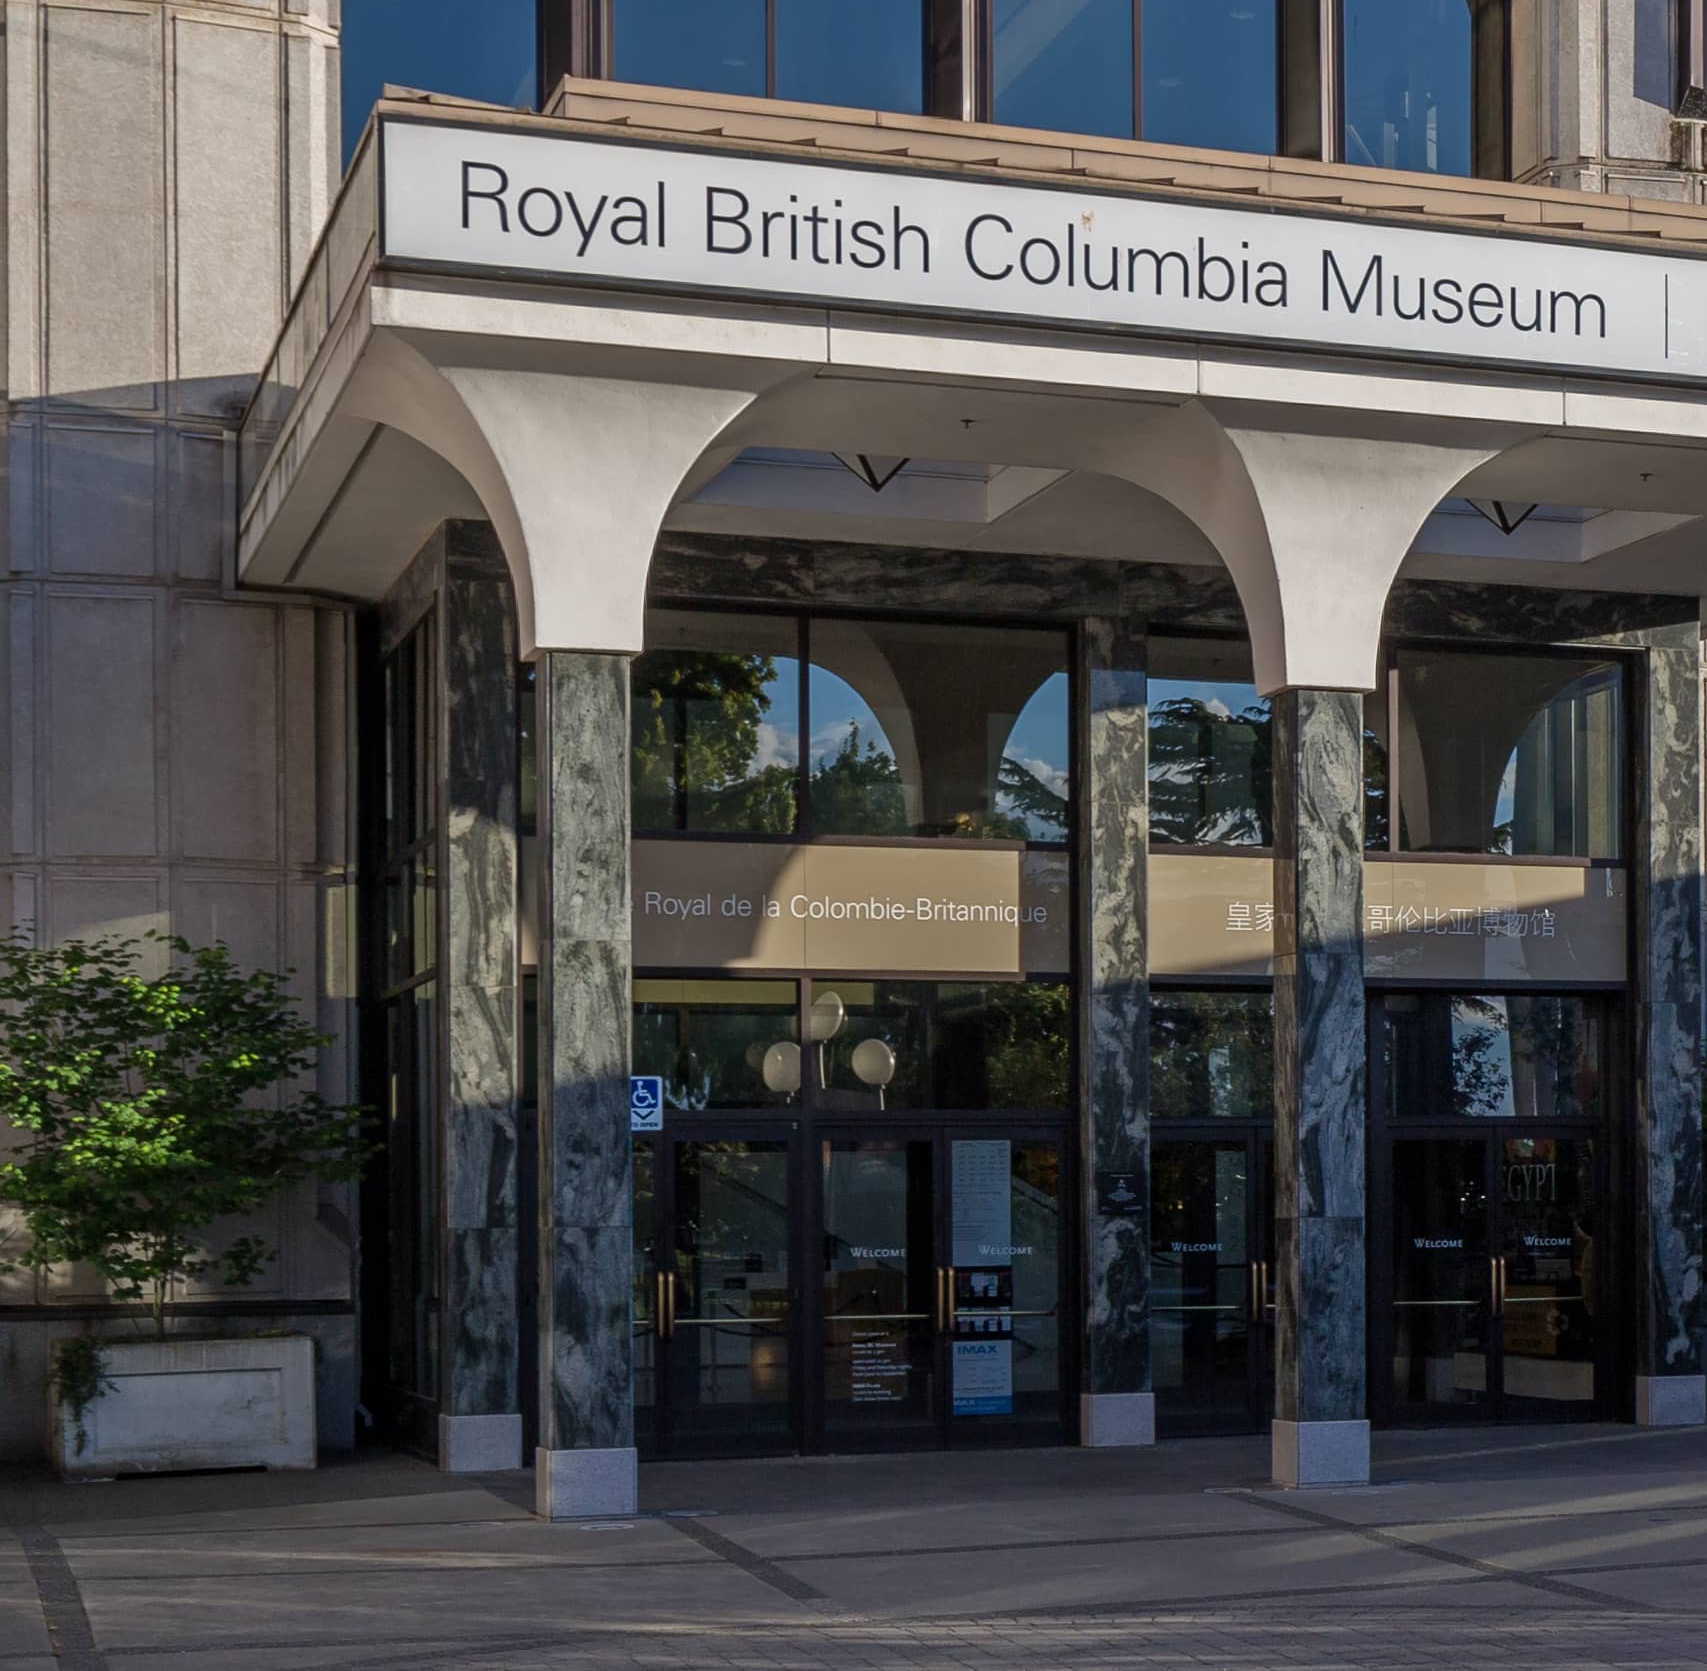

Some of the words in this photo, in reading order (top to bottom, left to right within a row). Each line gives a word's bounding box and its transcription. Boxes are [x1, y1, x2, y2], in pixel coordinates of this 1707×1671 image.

[460, 159, 667, 258] Royal
[705, 185, 931, 274] British
[965, 212, 1288, 309] Columbia
[1320, 248, 1607, 339] Museum
[644, 890, 712, 921] Royal
[720, 893, 753, 918] de
[762, 894, 781, 918] la
[790, 894, 1048, 927] Colombie-Britannique
[1170, 1241, 1225, 1252] WELCOME
[1413, 1237, 1464, 1249] WELCOME
[1523, 1235, 1572, 1247] WELCOME
[850, 1246, 907, 1258] WELCOME
[977, 1243, 1032, 1256] WELCOME
[957, 1345, 998, 1355] IMAX
